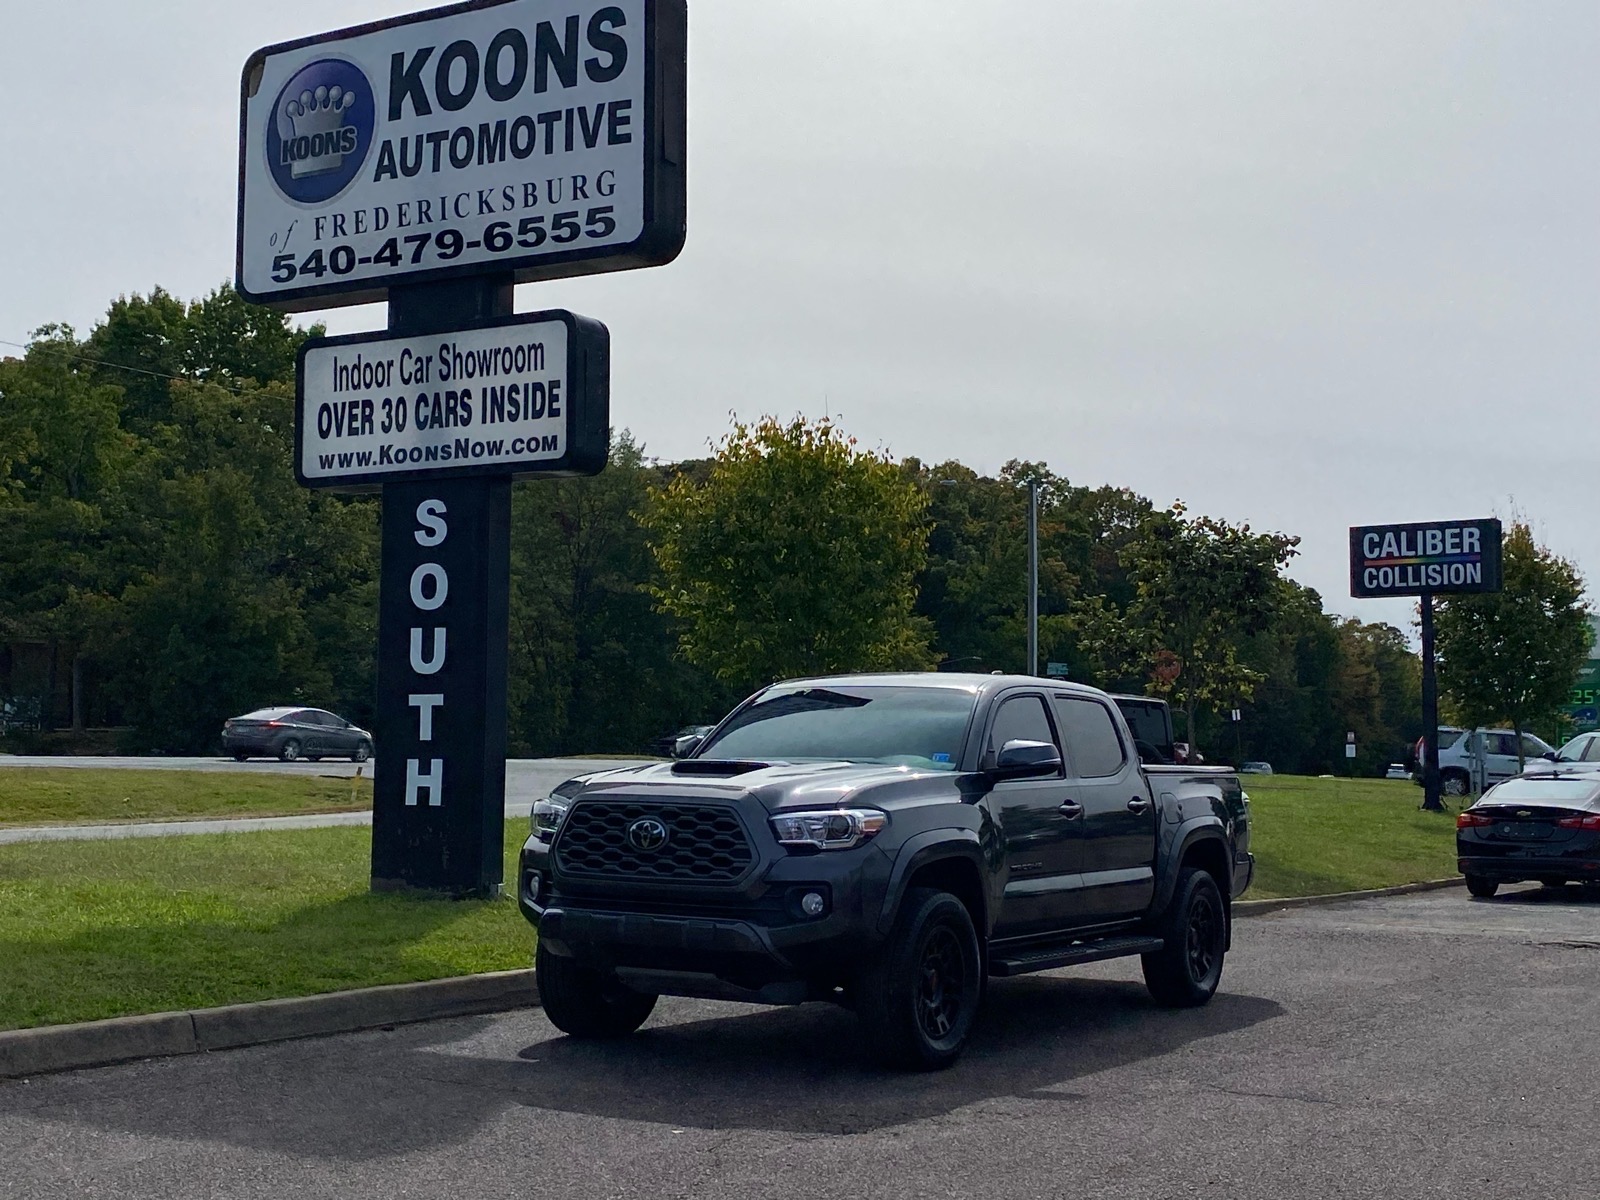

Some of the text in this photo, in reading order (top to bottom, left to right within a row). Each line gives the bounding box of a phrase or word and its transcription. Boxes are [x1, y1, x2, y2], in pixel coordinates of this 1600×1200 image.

[388, 5, 628, 121] KOONS
[280, 125, 357, 165] KOONS
[373, 99, 632, 183] AUTOMOTIVE
[270, 169, 616, 253] of FREDERICKSBURG
[271, 205, 616, 283] 540-479-6555
[333, 342, 545, 392] Indoor Car Showroom
[317, 380, 561, 439] OVER 30 CARS INSIDE
[1363, 527, 1481, 559] CALIBER
[1363, 562, 1482, 589] COLLISION
[405, 499, 449, 806] SOUTH
